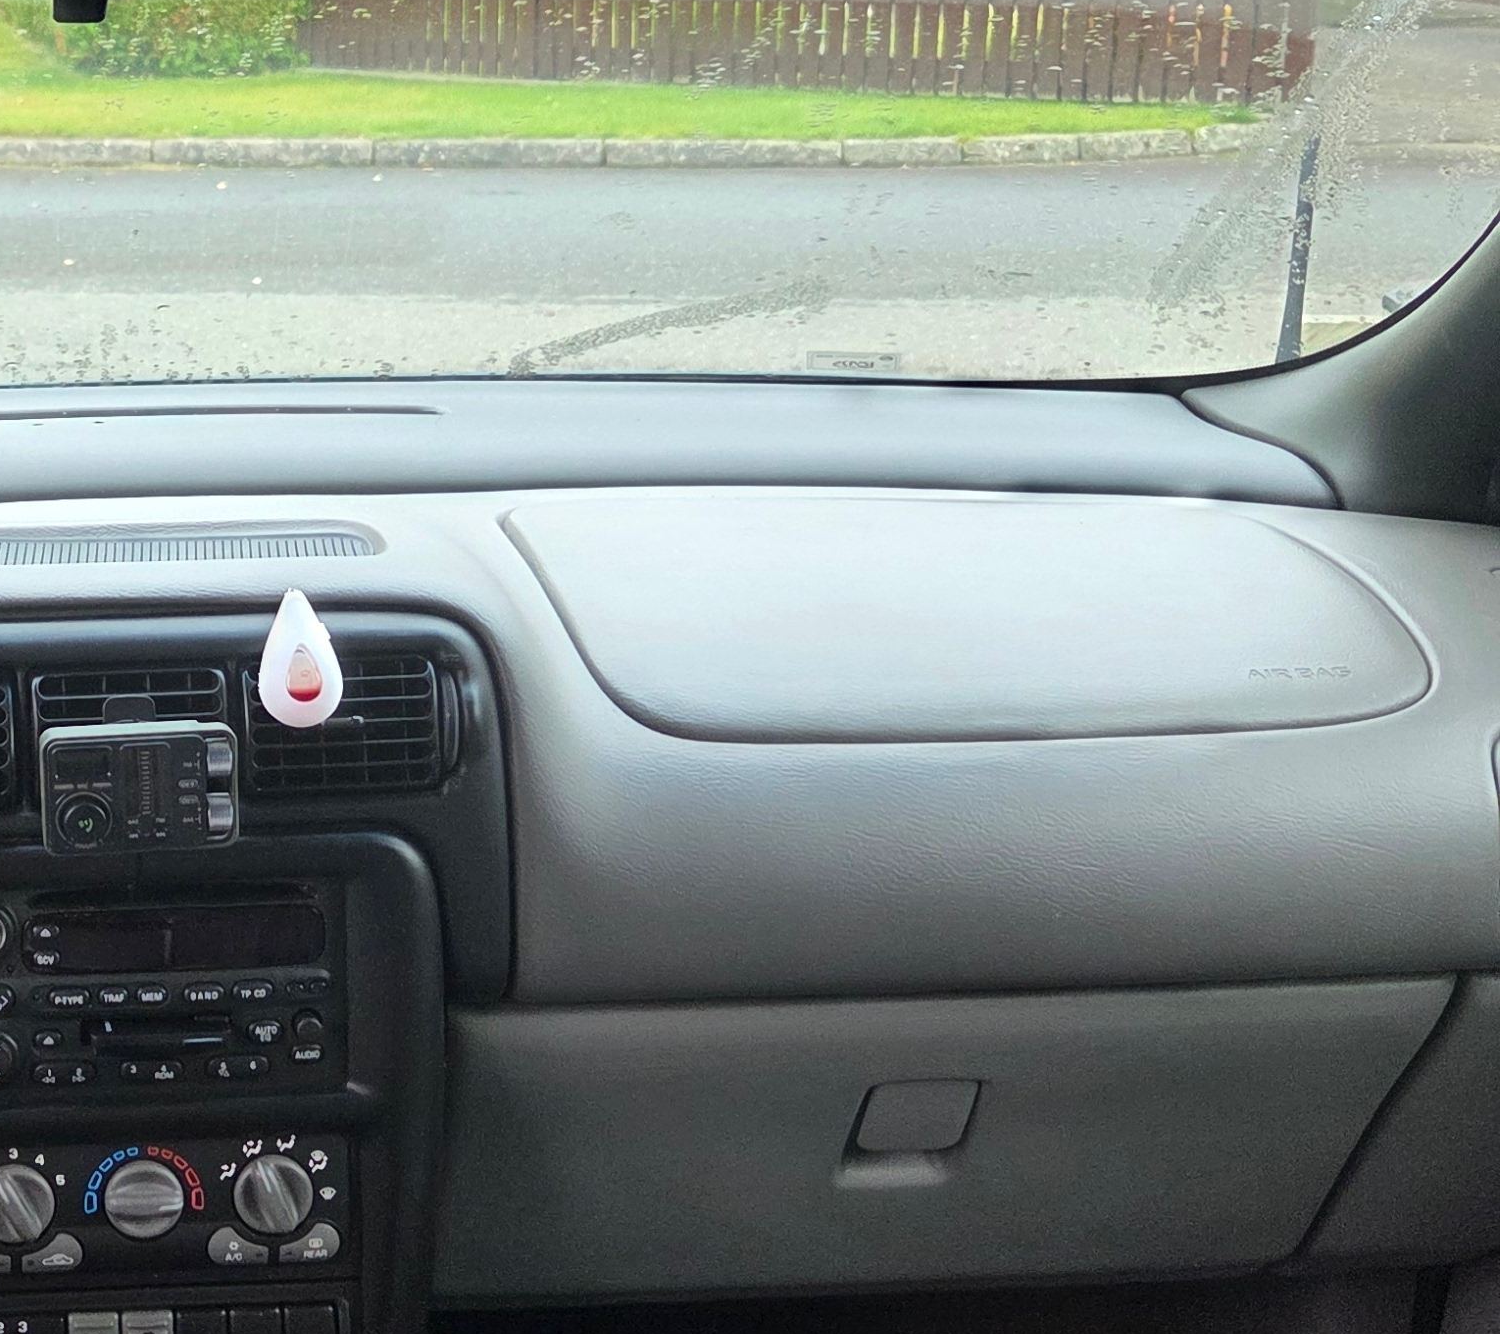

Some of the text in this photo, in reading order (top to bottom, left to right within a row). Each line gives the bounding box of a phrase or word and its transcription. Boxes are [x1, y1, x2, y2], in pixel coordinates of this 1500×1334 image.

[103, 993, 125, 1003] TRAF
[141, 992, 163, 1002] MEM
[190, 991, 219, 1001] BAND
[240, 989, 267, 999] TP CD
[54, 995, 84, 1005] P-TYPE
[255, 1026, 278, 1035] AUTO
[295, 1050, 321, 1060] AUDIO
[130, 1065, 137, 1074] 3
[160, 1064, 167, 1072] 4
[9, 1148, 18, 1159] 3
[35, 1154, 44, 1165] 4
[55, 1174, 65, 1186] 5
[225, 1252, 242, 1261] A/C
[303, 1249, 328, 1259] REAR
[18, 1320, 28, 1333] 3
